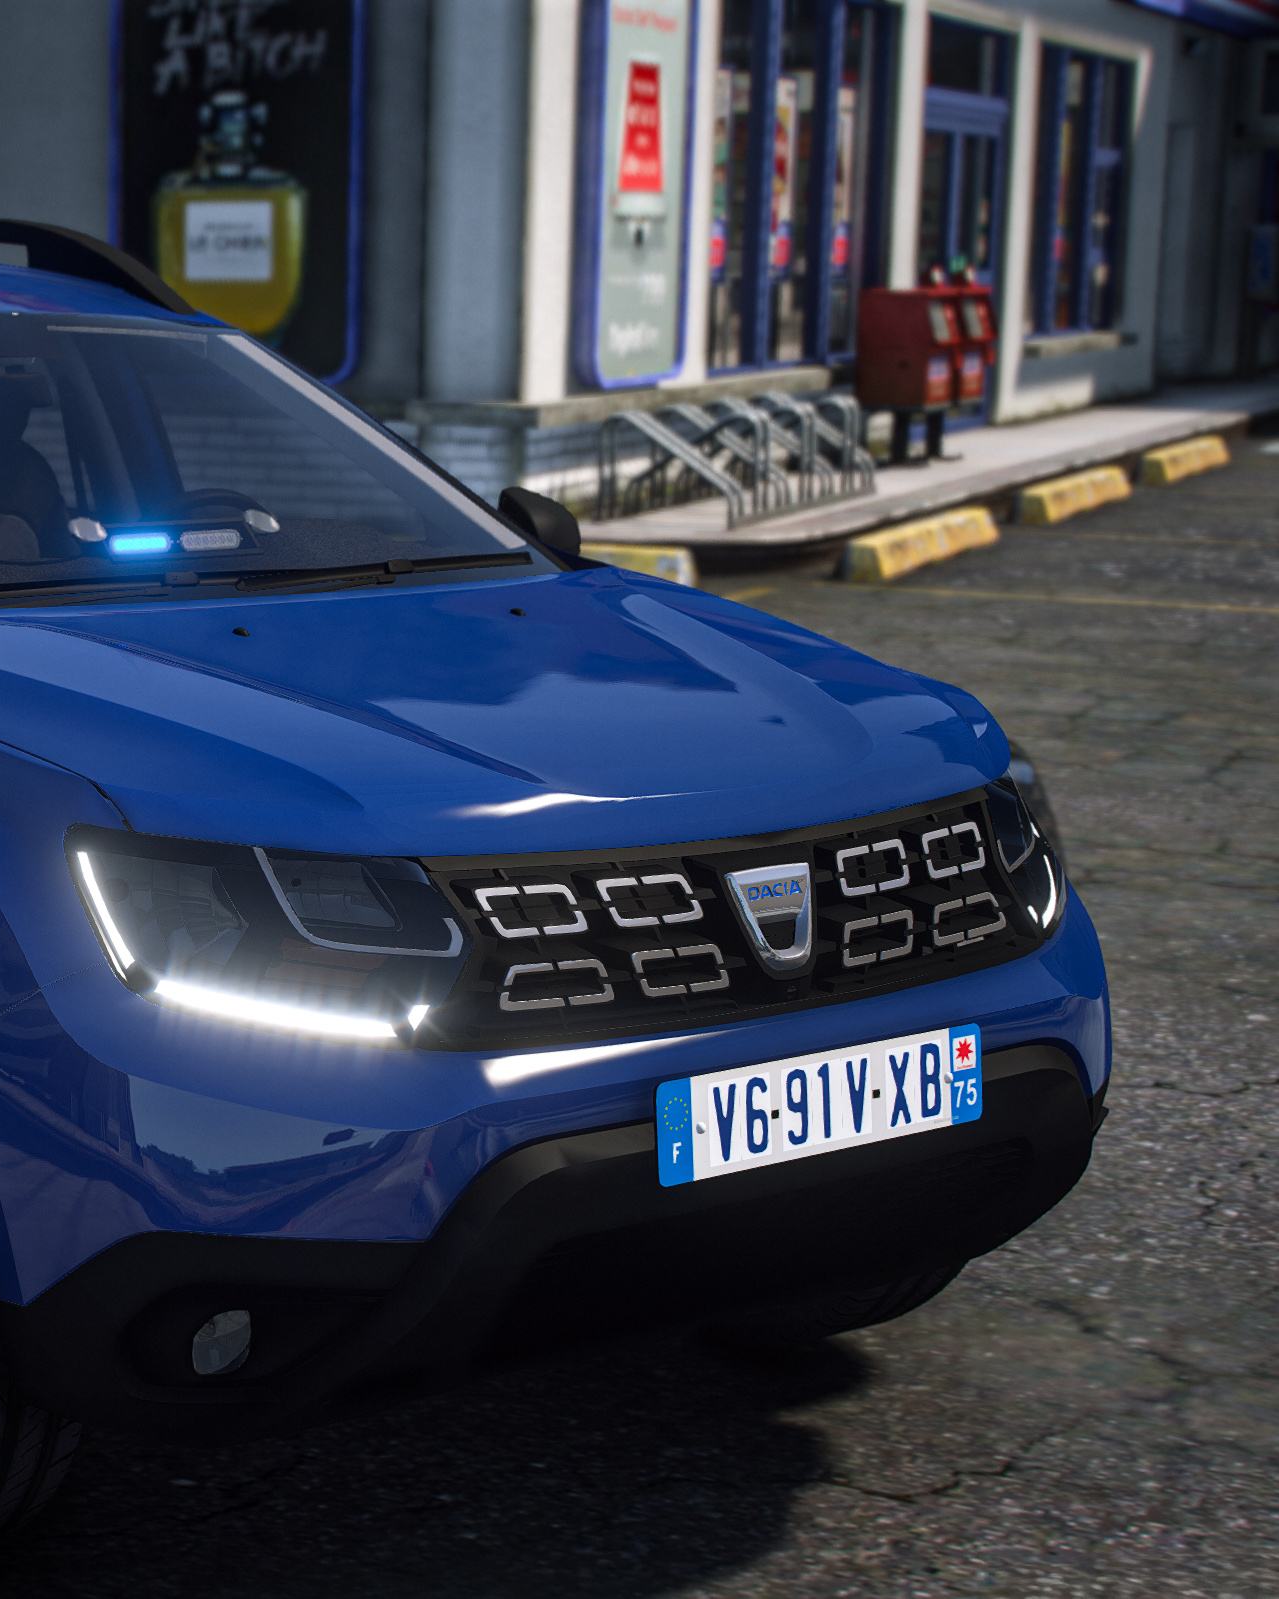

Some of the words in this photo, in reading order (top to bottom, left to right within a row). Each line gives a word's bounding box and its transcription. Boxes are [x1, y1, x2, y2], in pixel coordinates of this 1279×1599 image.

[153, 47, 189, 93] A
[201, 29, 328, 91] BITCH
[747, 880, 803, 901] DACIA
[953, 1078, 978, 1108] 75
[672, 1142, 682, 1164] F
